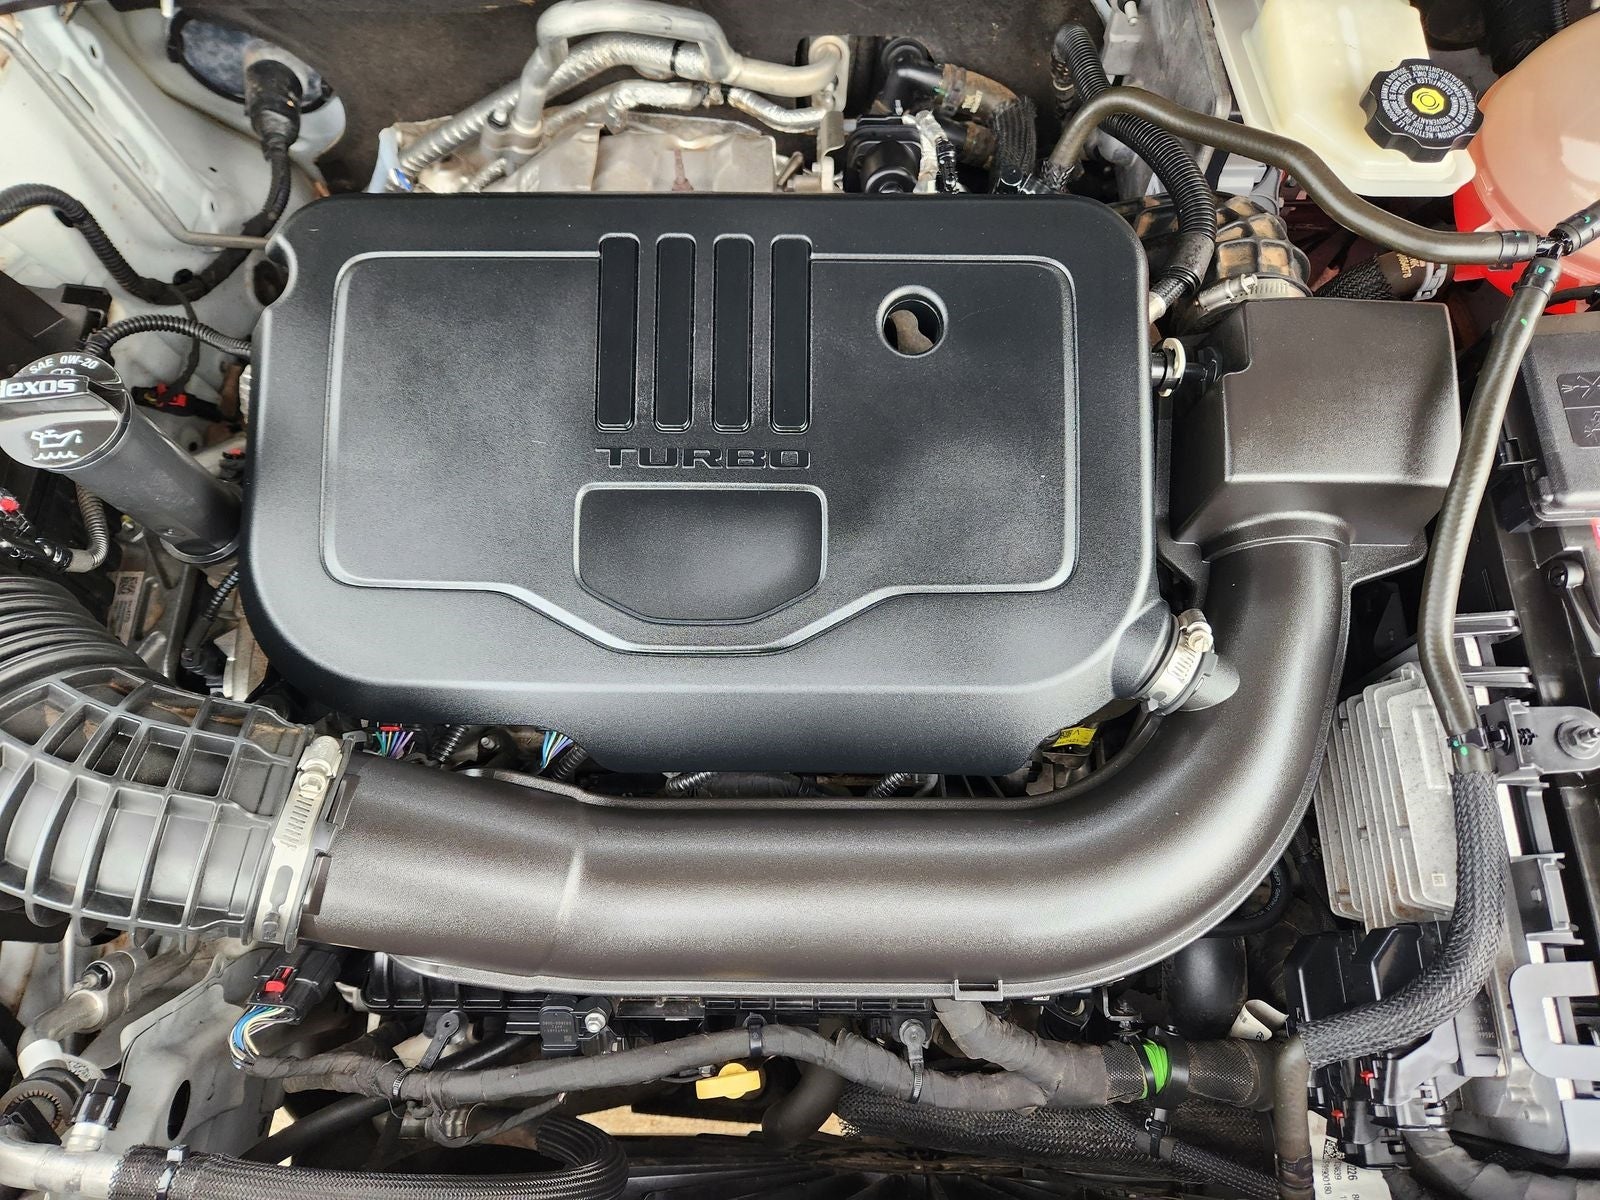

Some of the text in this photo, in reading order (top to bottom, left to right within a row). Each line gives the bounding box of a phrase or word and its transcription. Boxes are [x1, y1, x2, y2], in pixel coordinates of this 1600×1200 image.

[1428, 71, 1438, 79] USE
[1442, 70, 1463, 86] SEALED
[1395, 119, 1405, 127] LE
[1401, 115, 1412, 124] DU
[1410, 120, 1423, 130] QUE
[1403, 124, 1433, 138] NETTOYER
[30, 358, 54, 374] SAE
[595, 448, 810, 469] TURBO
